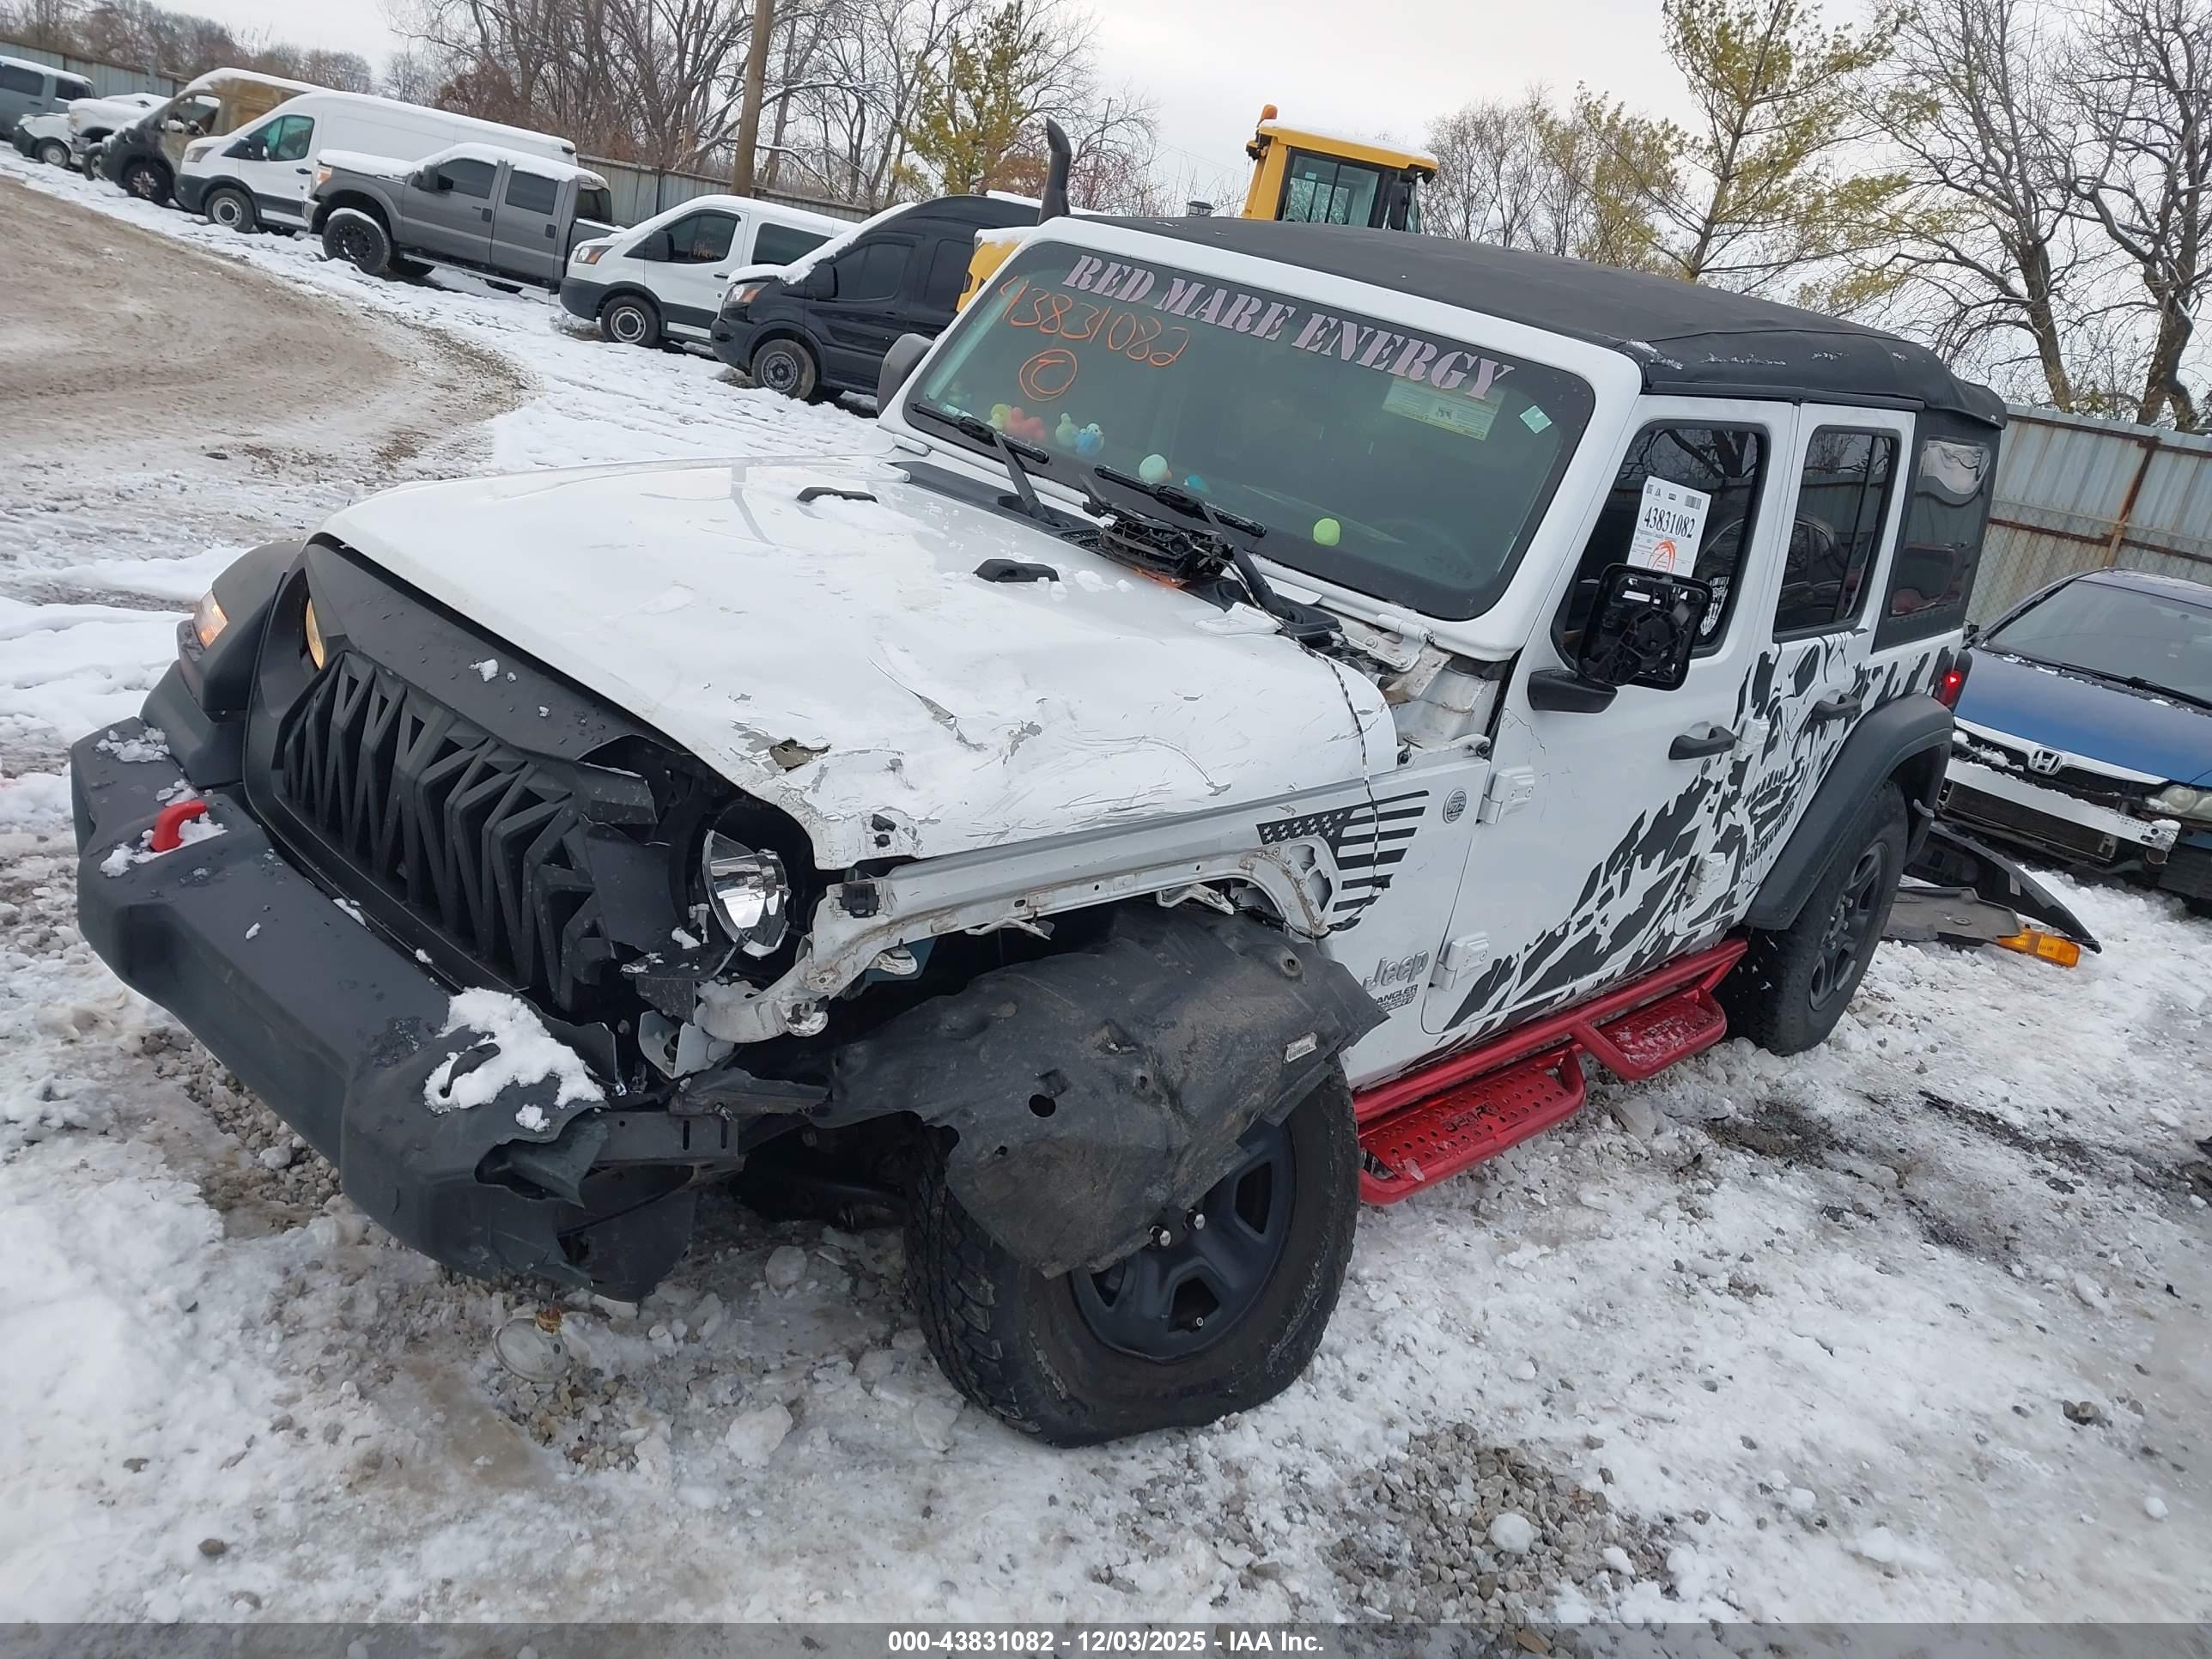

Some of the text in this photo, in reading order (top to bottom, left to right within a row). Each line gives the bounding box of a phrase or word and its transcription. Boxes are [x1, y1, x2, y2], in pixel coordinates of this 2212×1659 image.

[999, 275, 1190, 368] 43831082
[1061, 254, 1514, 401] RED MARE ENERGY
[1644, 506, 1696, 538] 43831082
[1362, 949, 1429, 991] Jeep
[1374, 984, 1418, 1004] ANGLER
